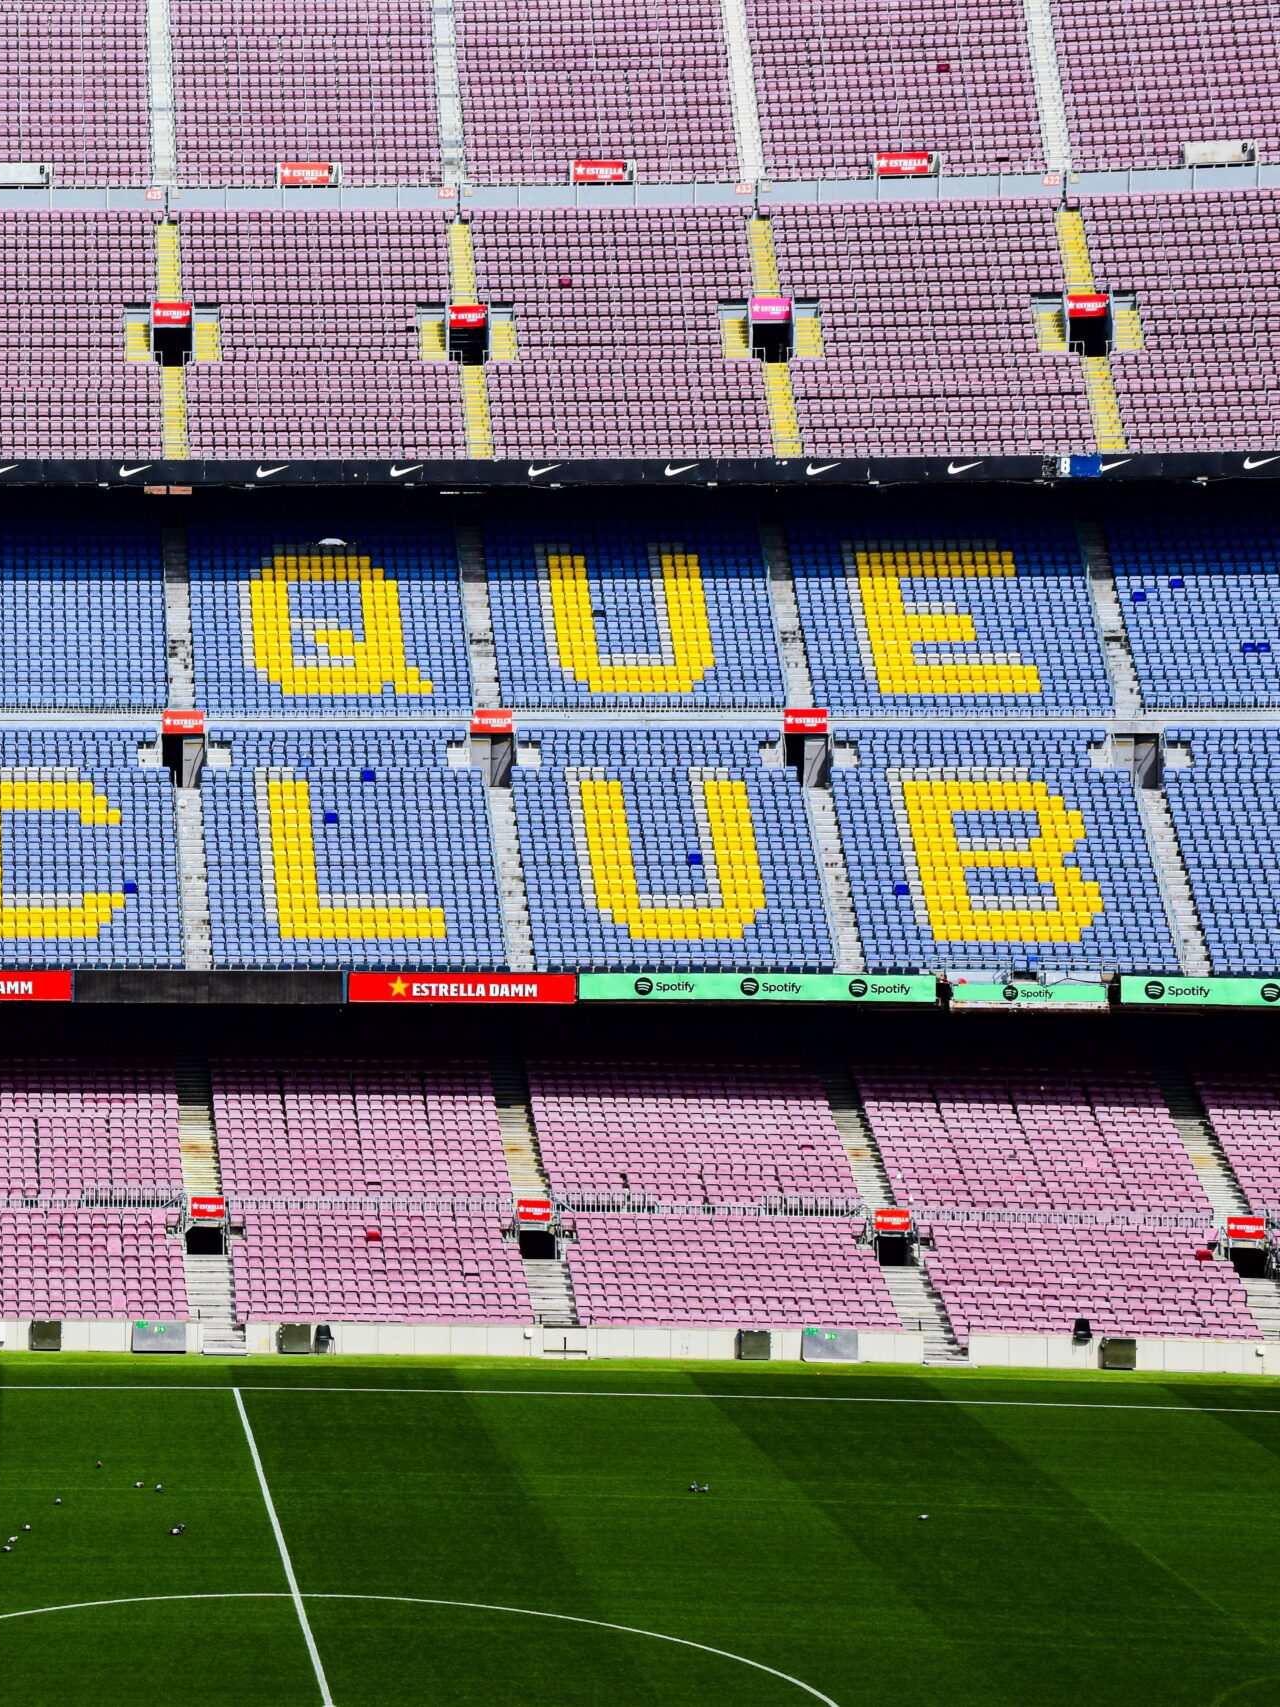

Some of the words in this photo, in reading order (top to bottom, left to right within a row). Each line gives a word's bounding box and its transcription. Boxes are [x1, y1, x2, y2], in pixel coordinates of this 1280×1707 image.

[889, 158, 928, 167] ESTRELLA
[292, 169, 329, 177] ESTRELLA
[586, 167, 623, 175] ESTRELLA
[1043, 176, 1060, 186] 432
[439, 188, 454, 197] 434
[735, 184, 752, 193] 433
[146, 190, 162, 200] 435
[248, 549, 1043, 694] QUE
[412, 983, 486, 996] ESTRELLA
[489, 983, 538, 997] DAMM
[655, 981, 695, 993] Spotify
[762, 982, 802, 994] Spotify
[870, 983, 910, 995] Spotify
[1168, 986, 1210, 998] Spotify
[1021, 989, 1053, 999] Spotify
